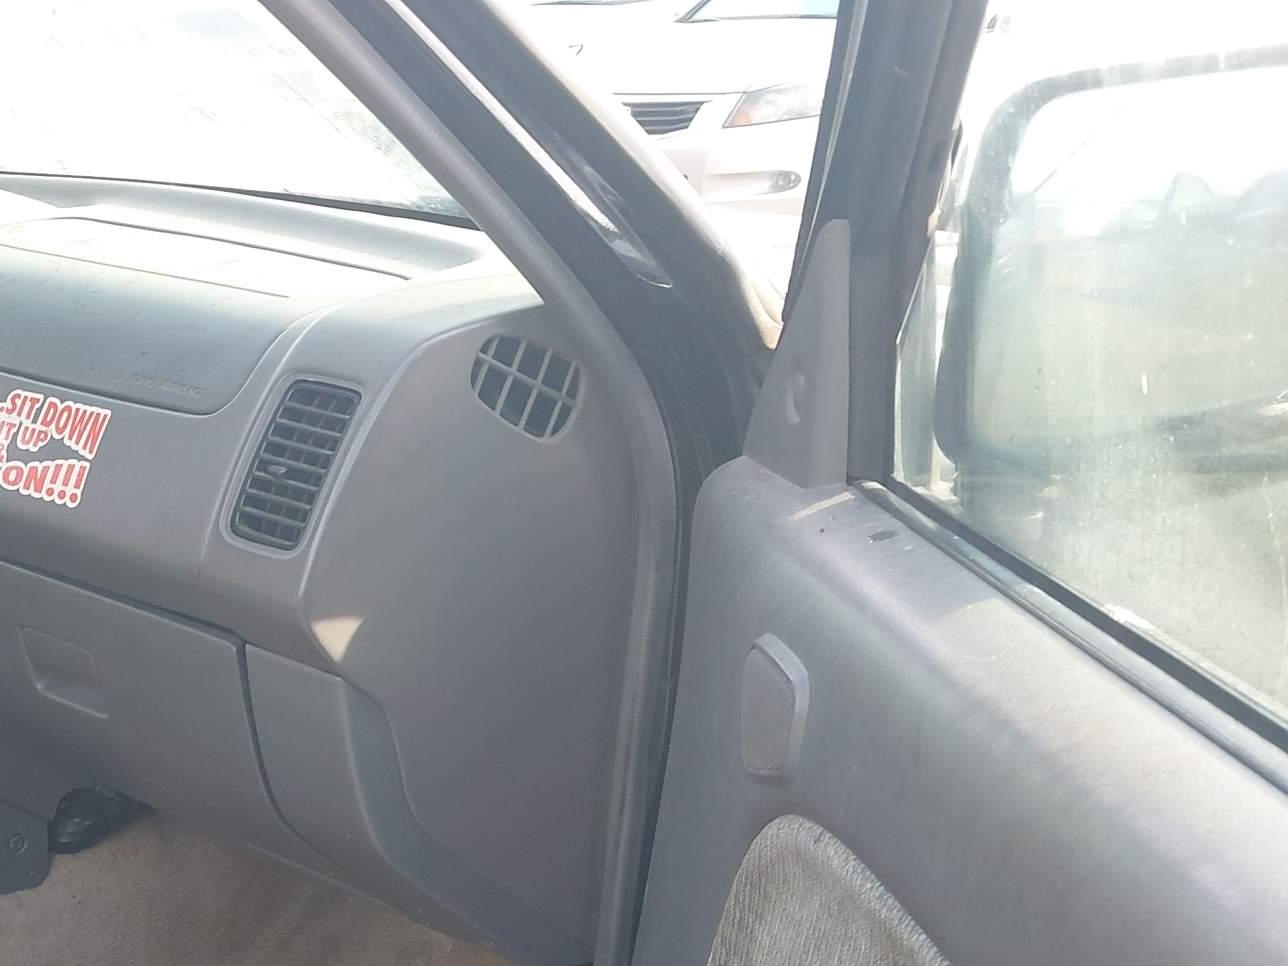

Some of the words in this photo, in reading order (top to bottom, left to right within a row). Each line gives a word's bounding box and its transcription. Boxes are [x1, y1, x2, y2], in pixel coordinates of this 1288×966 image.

[19, 425, 50, 449] UP
[39, 400, 109, 456] DOWN
[1, 462, 88, 505] ON!!!
